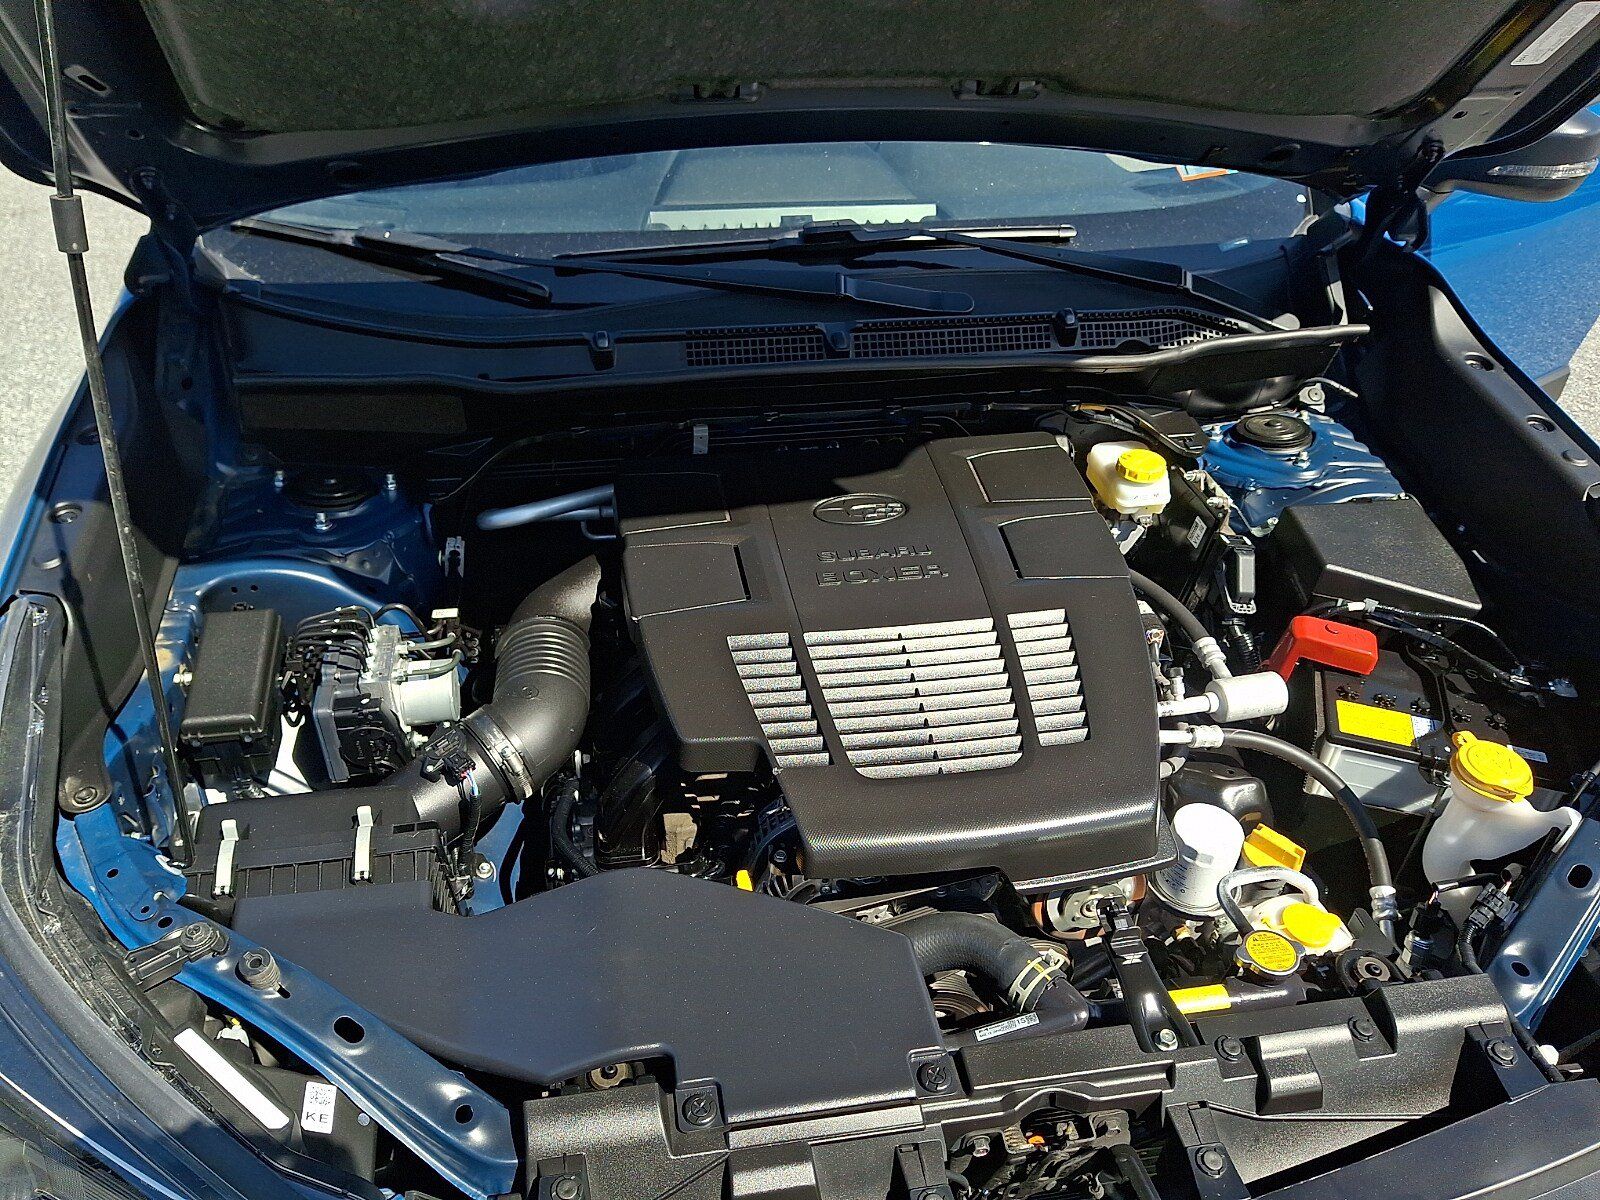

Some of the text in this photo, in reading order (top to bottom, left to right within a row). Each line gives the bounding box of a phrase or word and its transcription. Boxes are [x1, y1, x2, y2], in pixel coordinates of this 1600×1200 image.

[816, 544, 932, 562] SUBARU
[815, 564, 949, 587] BOXER
[305, 1111, 328, 1124] KE
